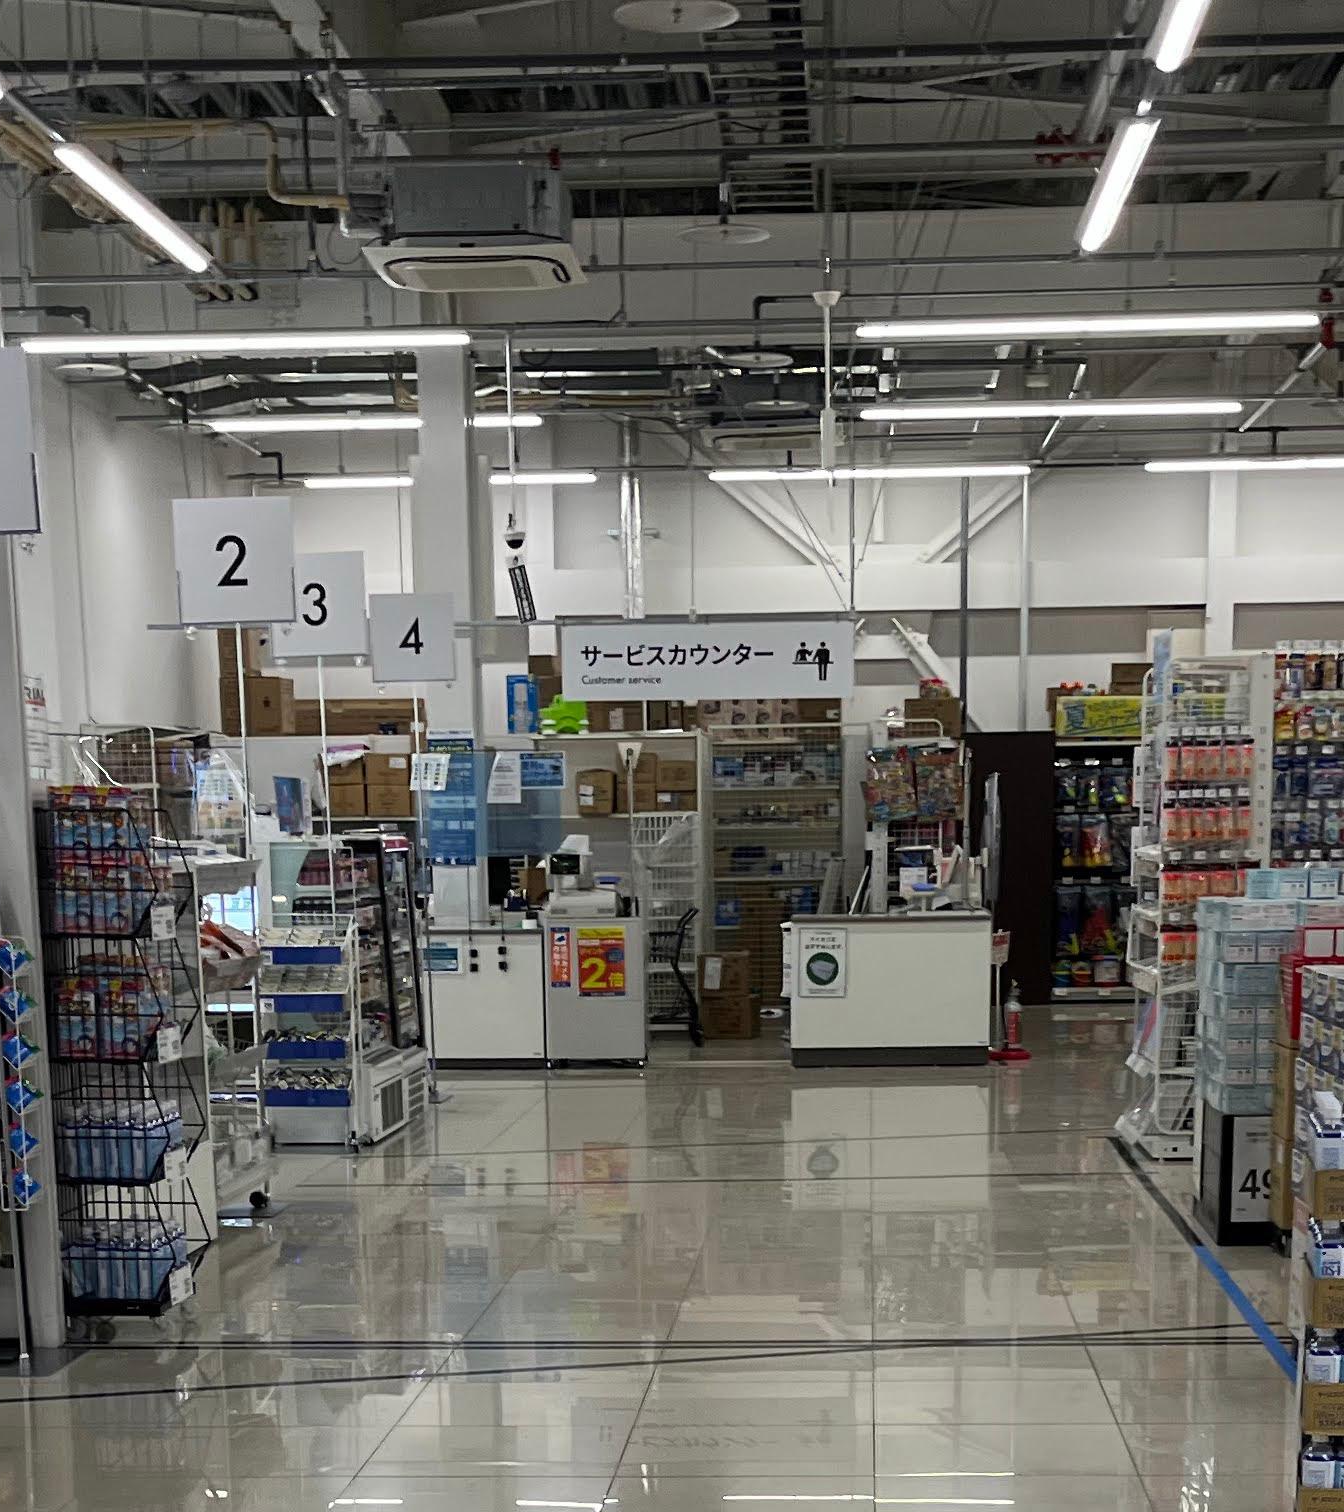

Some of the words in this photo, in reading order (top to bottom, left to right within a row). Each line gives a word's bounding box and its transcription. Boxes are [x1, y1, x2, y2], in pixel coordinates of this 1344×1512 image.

[216, 535, 248, 586] 2
[302, 582, 327, 625] 3
[399, 617, 423, 654] 4
[581, 643, 773, 666] サービスカウンター
[582, 675, 625, 685] Customer
[628, 676, 661, 685] service
